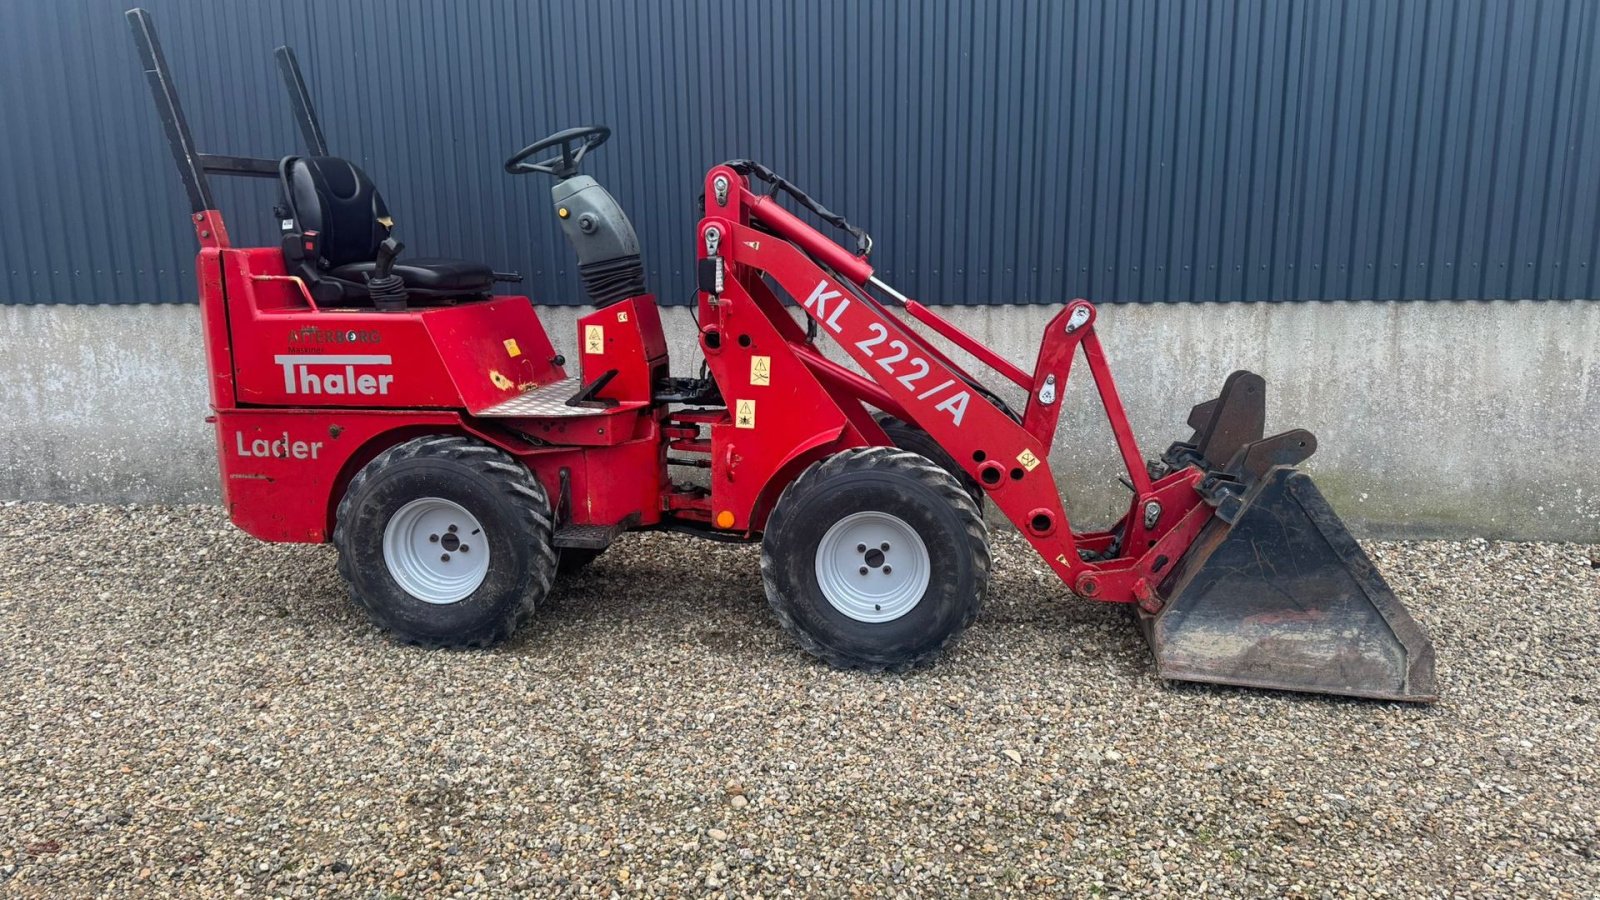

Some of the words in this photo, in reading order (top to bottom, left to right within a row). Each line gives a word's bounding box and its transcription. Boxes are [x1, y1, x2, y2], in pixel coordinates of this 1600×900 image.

[804, 279, 850, 333] KL
[854, 323, 970, 427] 222/A
[274, 355, 394, 395] Thaler
[236, 431, 323, 459] Lader
